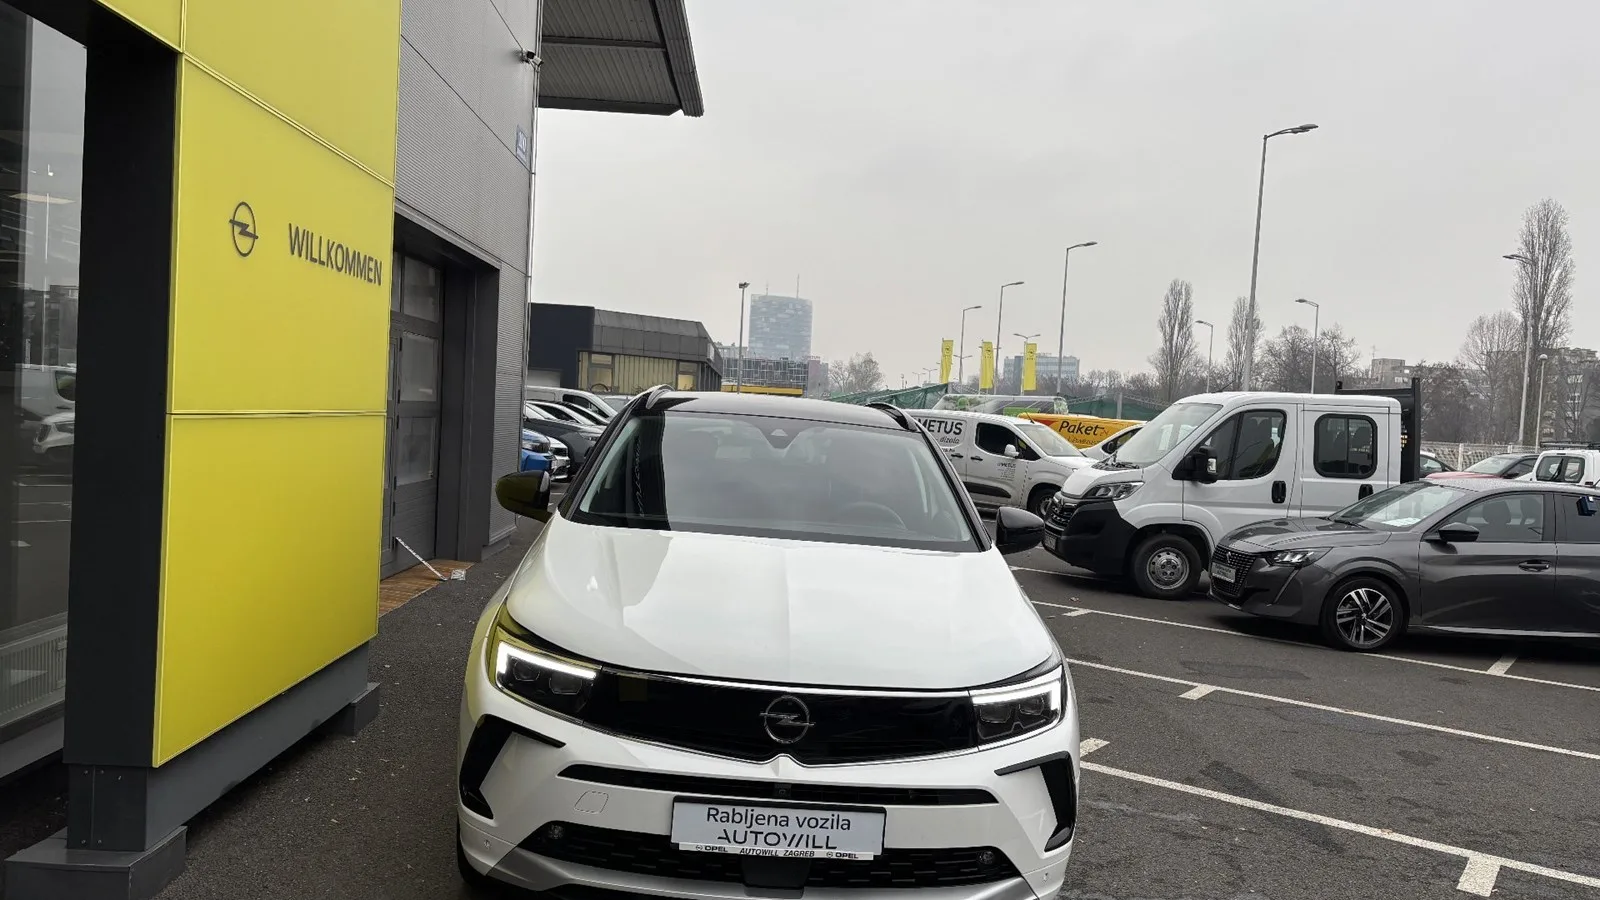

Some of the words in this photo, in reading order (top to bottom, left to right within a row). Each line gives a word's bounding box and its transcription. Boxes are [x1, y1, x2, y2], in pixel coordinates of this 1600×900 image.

[288, 222, 382, 286] WILLKOMMEN
[1058, 420, 1104, 436] Paket
[706, 807, 789, 829] Rabljena
[795, 813, 851, 831] vozila
[717, 828, 838, 850] AUTOWILL
[704, 845, 728, 853] OPEL
[739, 847, 779, 857] AUTOWILL
[783, 850, 815, 858] ZAGREB
[835, 851, 859, 859] OPEL
